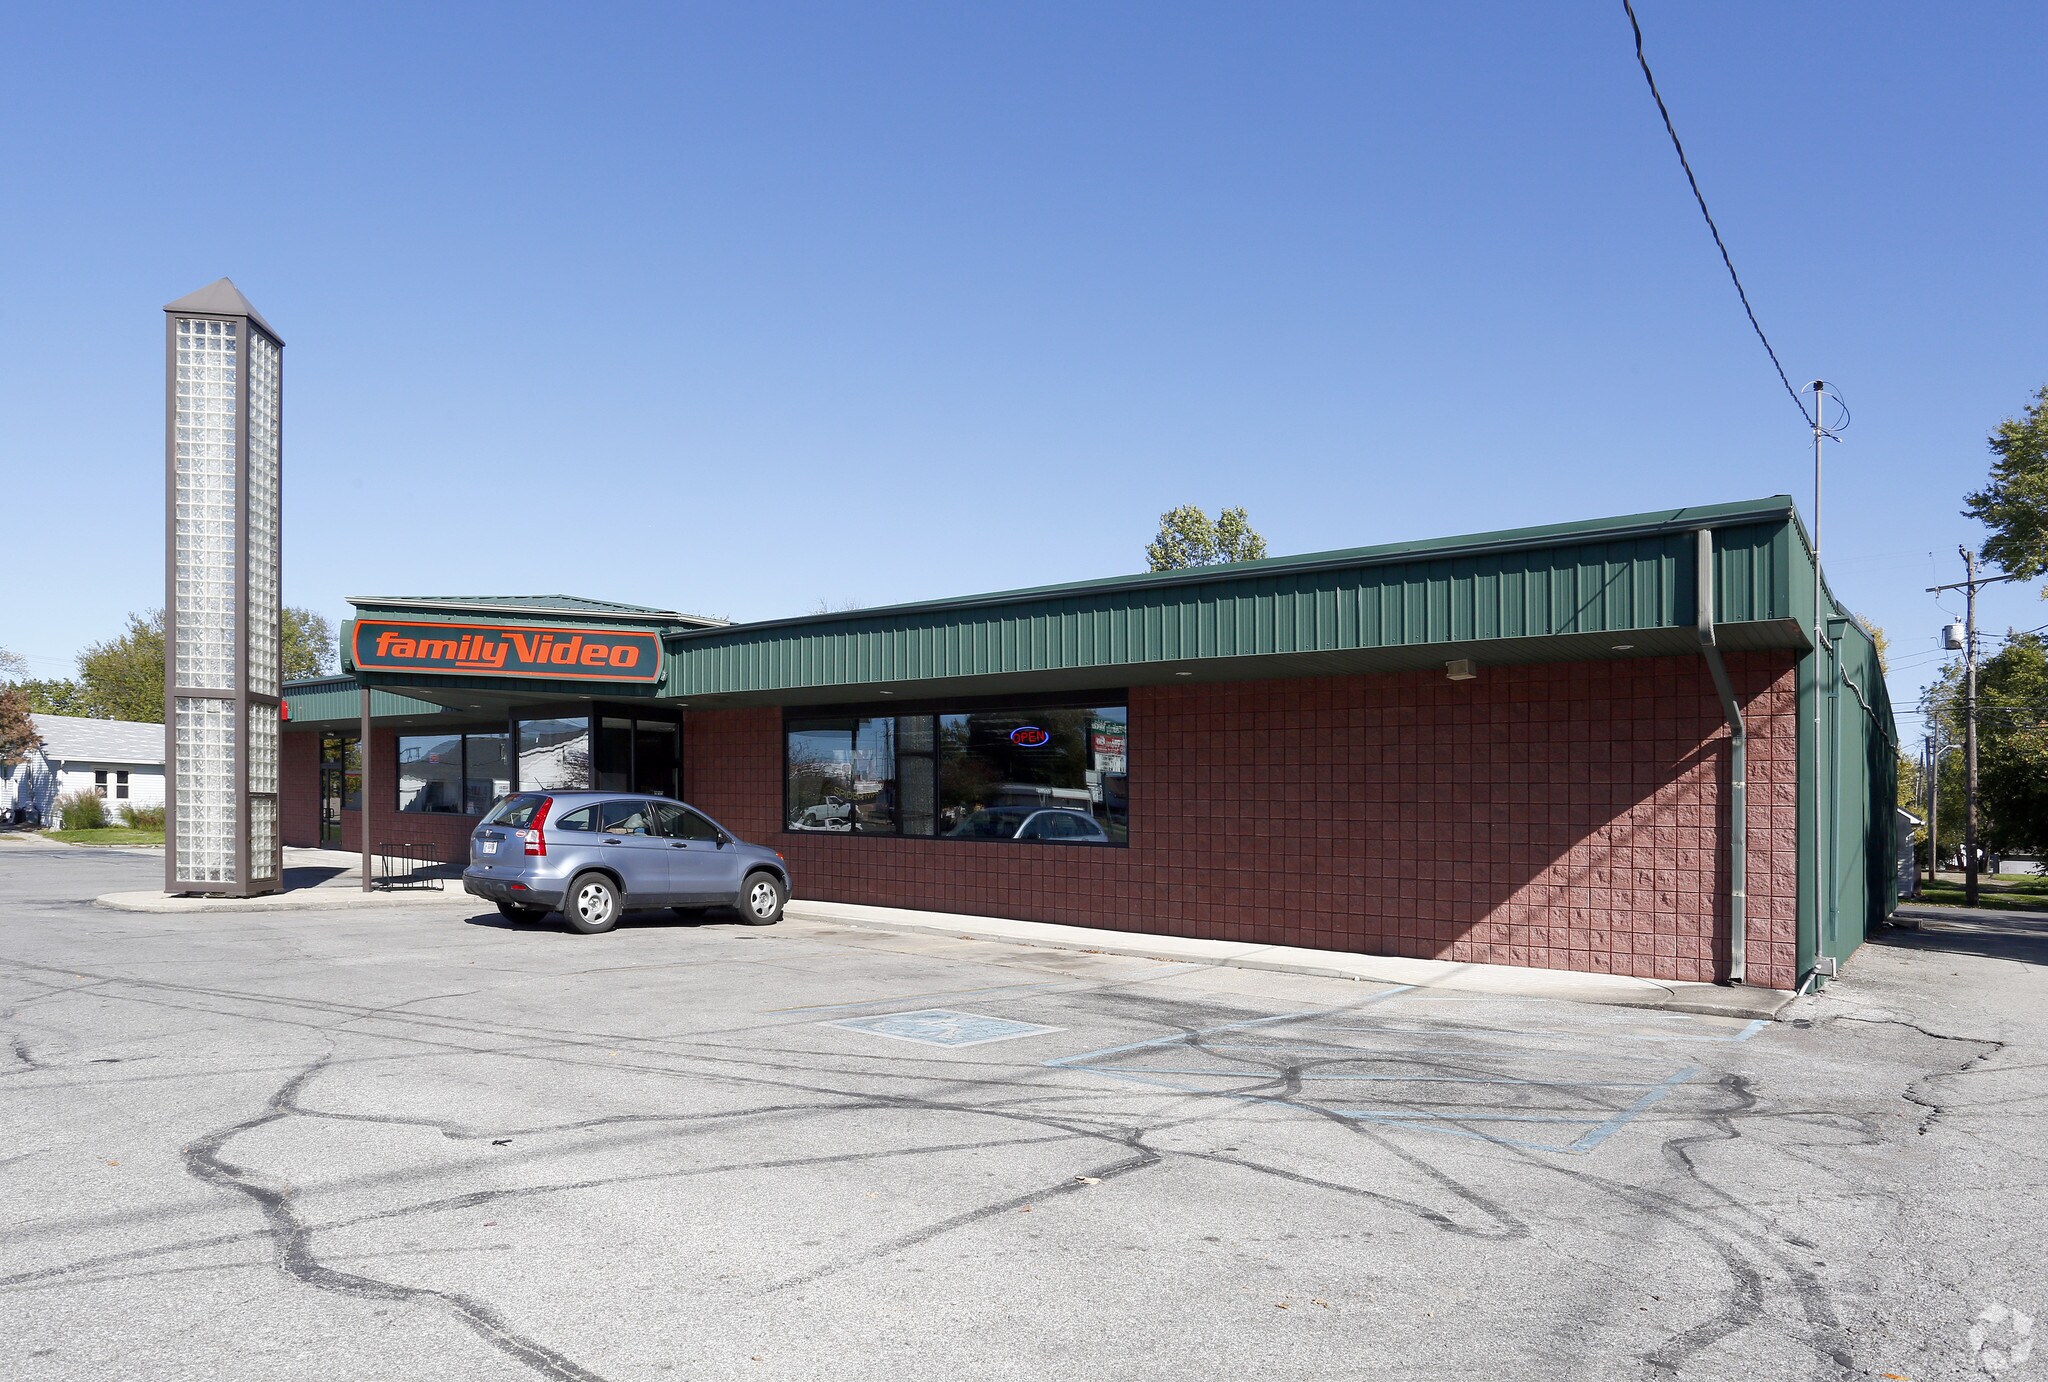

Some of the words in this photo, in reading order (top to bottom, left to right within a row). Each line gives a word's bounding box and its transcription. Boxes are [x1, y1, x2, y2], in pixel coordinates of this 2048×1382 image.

[376, 632, 508, 667] family
[502, 633, 639, 667] Video
[1012, 730, 1045, 744] OPEN
